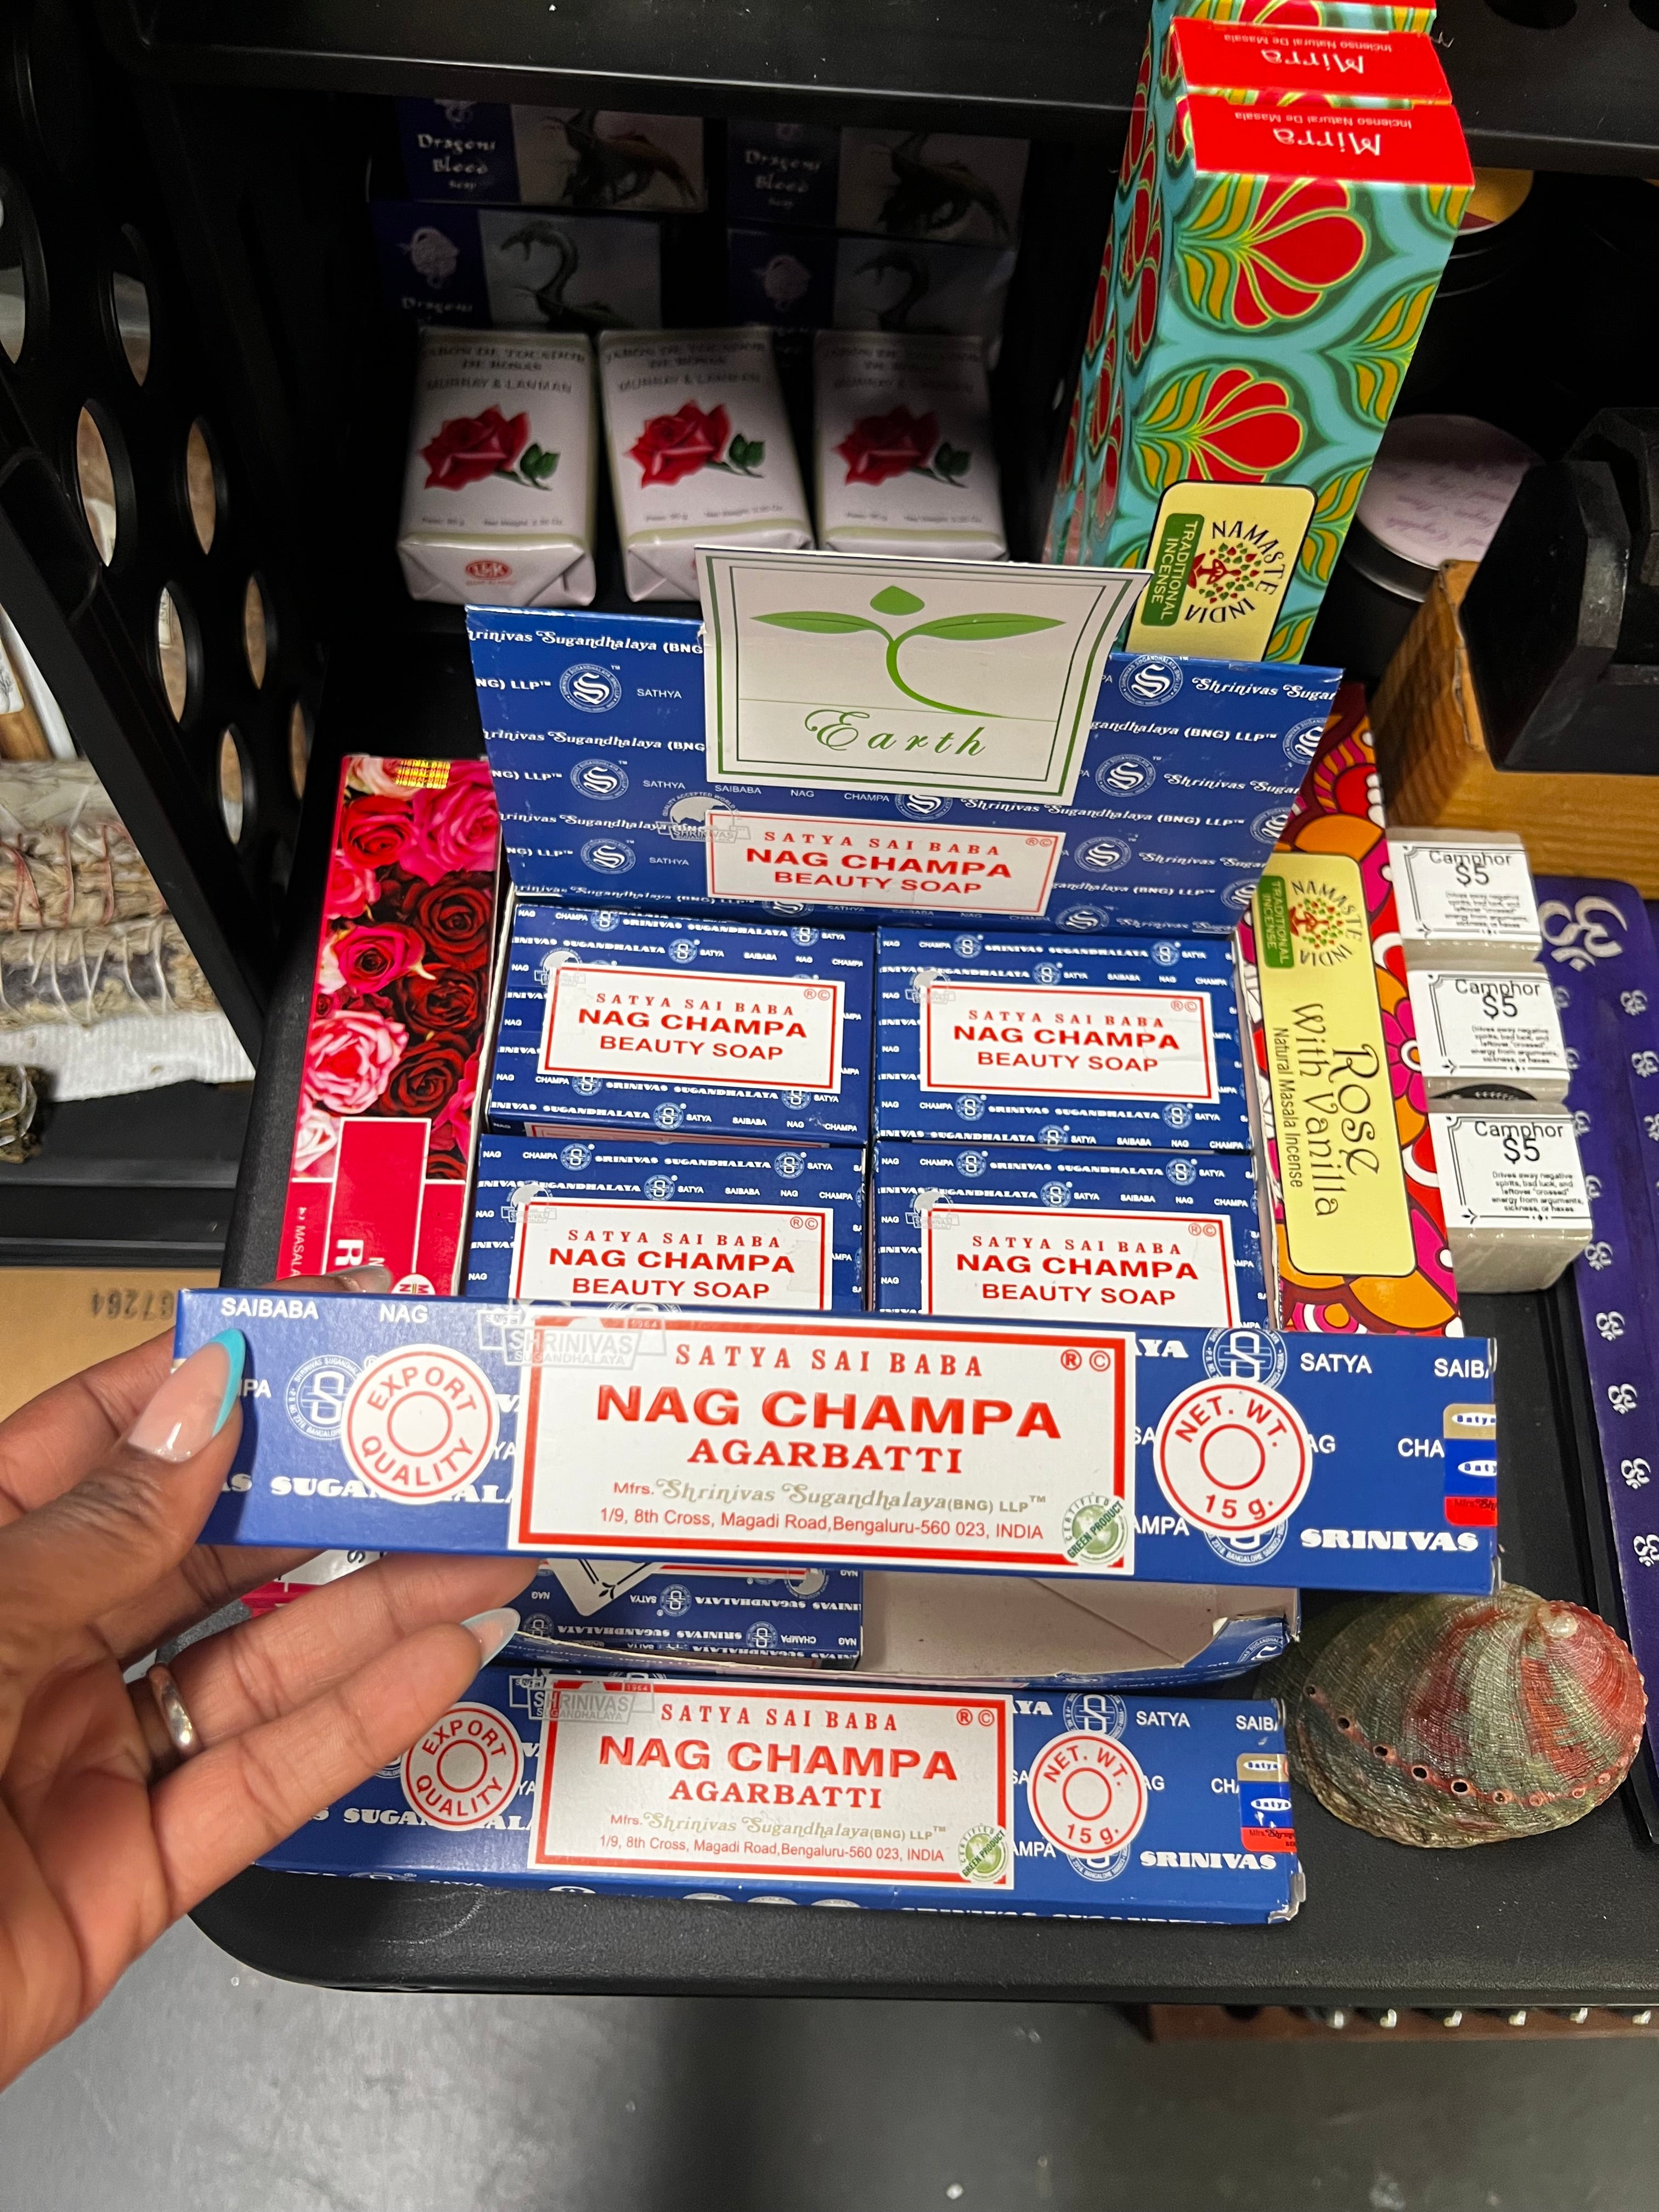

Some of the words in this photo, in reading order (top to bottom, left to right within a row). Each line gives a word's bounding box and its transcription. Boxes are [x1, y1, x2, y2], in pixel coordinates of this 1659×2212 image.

[1340, 43, 1391, 52] Incienso
[1261, 49, 1364, 74] Mirra
[1234, 111, 1281, 121] Masala
[1286, 114, 1301, 123] De
[1307, 115, 1354, 125] Natural
[1357, 119, 1412, 128] Incienso
[1273, 128, 1380, 156] Mirra
[432, 157, 488, 174] Blood
[1152, 538, 1177, 603] INCENSE
[1161, 521, 1198, 620] TRADITIONAL
[1212, 521, 1286, 595] NAMASTE
[1184, 598, 1255, 624] INDIA
[536, 631, 657, 651] Sugandhalaya
[637, 689, 681, 699] SATHYA
[1192, 677, 1278, 696] Shrinivas
[548, 731, 661, 749] Sugandhalaya
[805, 709, 987, 757] Earth
[1184, 727, 1230, 741] (BNG)
[643, 780, 685, 789] SATHYA
[715, 785, 761, 794] SAIBABA
[790, 789, 814, 798] NAG
[844, 792, 889, 802] CHAMPA
[765, 831, 853, 847] SATYA
[869, 838, 913, 850] SAI
[929, 842, 1000, 855] BABA
[746, 848, 828, 867] NAG
[841, 853, 1012, 878] CHAMPA
[1430, 850, 1512, 866] Camphor
[775, 871, 892, 889] BEAUTY
[900, 879, 981, 894] SOAP
[1456, 863, 1489, 886] $5
[1262, 893, 1277, 950] INCENSE
[1271, 881, 1289, 964] TRADITIONAL
[1292, 881, 1363, 942] NAMASTE
[1455, 979, 1541, 997] Camphor
[596, 993, 670, 1008] SATYA
[685, 999, 722, 1011] SAI
[735, 1002, 794, 1015] BABA
[1482, 994, 1517, 1019] $5
[579, 1009, 650, 1028] NAG
[661, 1014, 807, 1038] CHAMPA
[969, 1010, 1042, 1023] SATYA
[1056, 1014, 1091, 1024] SAI
[1105, 1016, 1164, 1028] BABA
[600, 1036, 705, 1056] BEAUTY
[713, 1043, 783, 1060] SOAP
[954, 1026, 1023, 1043] NAG
[1034, 1030, 1180, 1049] CHAMPA
[1292, 1003, 1330, 1077] With
[978, 1052, 1079, 1069] BEAUTY
[1088, 1056, 1158, 1072] SOAP
[1273, 1027, 1289, 1076] Natural
[1279, 1079, 1296, 1128] Masala
[1328, 1043, 1380, 1175] Rose
[1475, 1121, 1562, 1138] Camphor
[595, 1155, 658, 1164] SRINIVAS
[665, 1158, 771, 1169] SUGANDHALAYA
[1284, 1132, 1302, 1188] Incense
[1303, 1092, 1347, 1217] Vanilla
[1503, 1137, 1540, 1164] $5
[289, 1225, 307, 1276] MASALA
[569, 1230, 648, 1243] SATYA
[663, 1233, 703, 1245] SAI
[717, 1235, 780, 1248] BABA
[973, 1235, 1051, 1249] SATYA
[1065, 1239, 1104, 1250] SAI
[1118, 1242, 1181, 1255] BABA
[549, 1249, 625, 1267] NAG
[637, 1251, 795, 1273] CHAMPA
[957, 1254, 1030, 1273] NAG
[1042, 1257, 1198, 1280] CHAMPA
[573, 1278, 686, 1296] BEAUTY
[694, 1283, 769, 1299] SOAP
[983, 1284, 1092, 1302] BEAUTY
[1101, 1288, 1175, 1305] SOAP
[221, 1297, 319, 1319] SAIBABA
[380, 1305, 427, 1323] NAG
[511, 1330, 634, 1354] SHRINIVAS
[676, 1344, 790, 1369] SATYA
[812, 1349, 870, 1372] SAI
[890, 1352, 983, 1377] BABA
[1300, 1353, 1372, 1374] SATYA
[367, 1365, 477, 1412] EXPORT
[597, 1385, 738, 1426] NAG
[761, 1390, 1062, 1439] CHAMPA
[1175, 1396, 1234, 1443] NET.
[1246, 1398, 1287, 1448] WT.
[362, 1435, 473, 1487] QUALITY
[687, 1438, 962, 1474] AGARBATTI
[614, 1482, 654, 1495] Mfrs.
[656, 1478, 775, 1504] Shrinivas
[1205, 1494, 1237, 1519] 15
[1248, 1498, 1273, 1520] g.
[601, 1508, 628, 1525] 1/9,
[634, 1509, 658, 1523] 8th
[664, 1510, 715, 1527] Cross,
[721, 1513, 779, 1529] Magadi
[955, 1522, 989, 1539] 023,
[996, 1525, 1043, 1539] INDIA
[1068, 1532, 1092, 1558] GREEN
[1090, 1500, 1124, 1535] PRODUCT
[1300, 1528, 1478, 1552] SRINIVAS
[534, 1691, 628, 1712] SHRINIVAS
[662, 1703, 750, 1724] SATYA
[766, 1709, 811, 1727] SAI
[826, 1711, 896, 1731] BABA
[1136, 1711, 1190, 1728] SATYA
[422, 1719, 506, 1757] EXPORT
[600, 1736, 710, 1771] NAG
[727, 1741, 957, 1780] CHAMPA
[1043, 1745, 1087, 1782] NET.
[1097, 1748, 1127, 1786] WT.
[416, 1774, 503, 1817] QUALITY
[669, 1780, 882, 1809] AGARBATTI
[611, 1815, 642, 1826] Mfrs.
[644, 1813, 736, 1833] Shrinivas
[1066, 1825, 1091, 1843] 15
[1100, 1826, 1119, 1844] g.
[600, 1836, 622, 1849] 1/9,
[627, 1837, 645, 1848] 8th
[650, 1838, 690, 1852] Cross,
[694, 1840, 740, 1855] Magadi
[877, 1847, 903, 1861] 023,
[907, 1849, 944, 1861] INDIA
[980, 1830, 1005, 1858] PRODUCT
[1141, 1851, 1276, 1870] SRINIVAS
